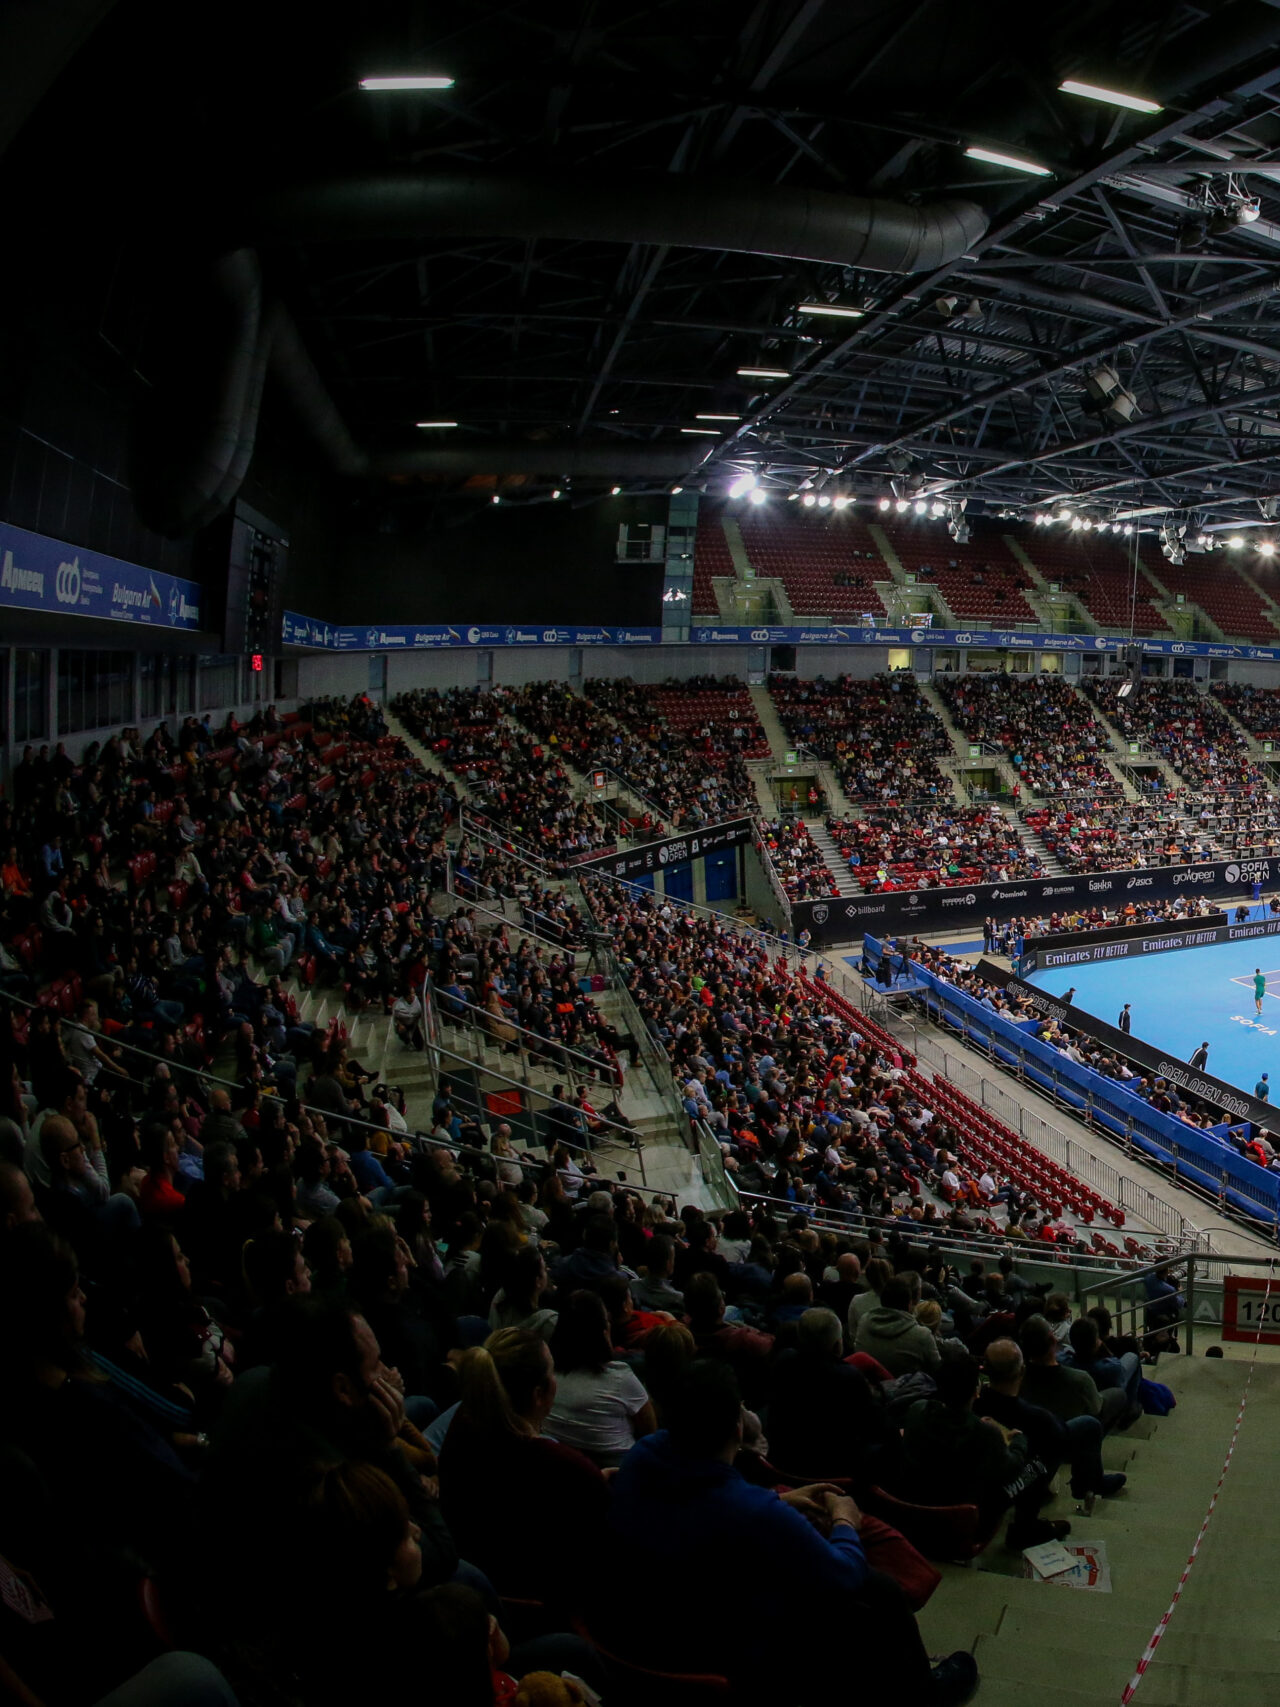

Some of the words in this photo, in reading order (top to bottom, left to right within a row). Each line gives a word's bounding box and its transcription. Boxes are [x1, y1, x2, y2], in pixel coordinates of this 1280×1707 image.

[668, 841, 686, 854] SOFIA
[668, 850, 688, 862] OPEN
[1241, 861, 1270, 872] SOFIA
[1240, 870, 1270, 882] OPN
[1000, 890, 1028, 899] Domino's
[858, 904, 886, 915] billboard
[1229, 926, 1264, 938] Emirates
[1268, 924, 1277, 933] FLY
[1142, 937, 1182, 952] Emirates
[1185, 934, 1196, 945] FLY
[1196, 932, 1217, 944] BETTER
[1046, 951, 1090, 966] Emirates
[1094, 948, 1105, 959] FLY
[1106, 944, 1128, 957] BETTER
[1230, 1015, 1278, 1036] SOFIA
[1158, 1062, 1190, 1087] SOFIA
[1189, 1078, 1222, 1100] OPEN
